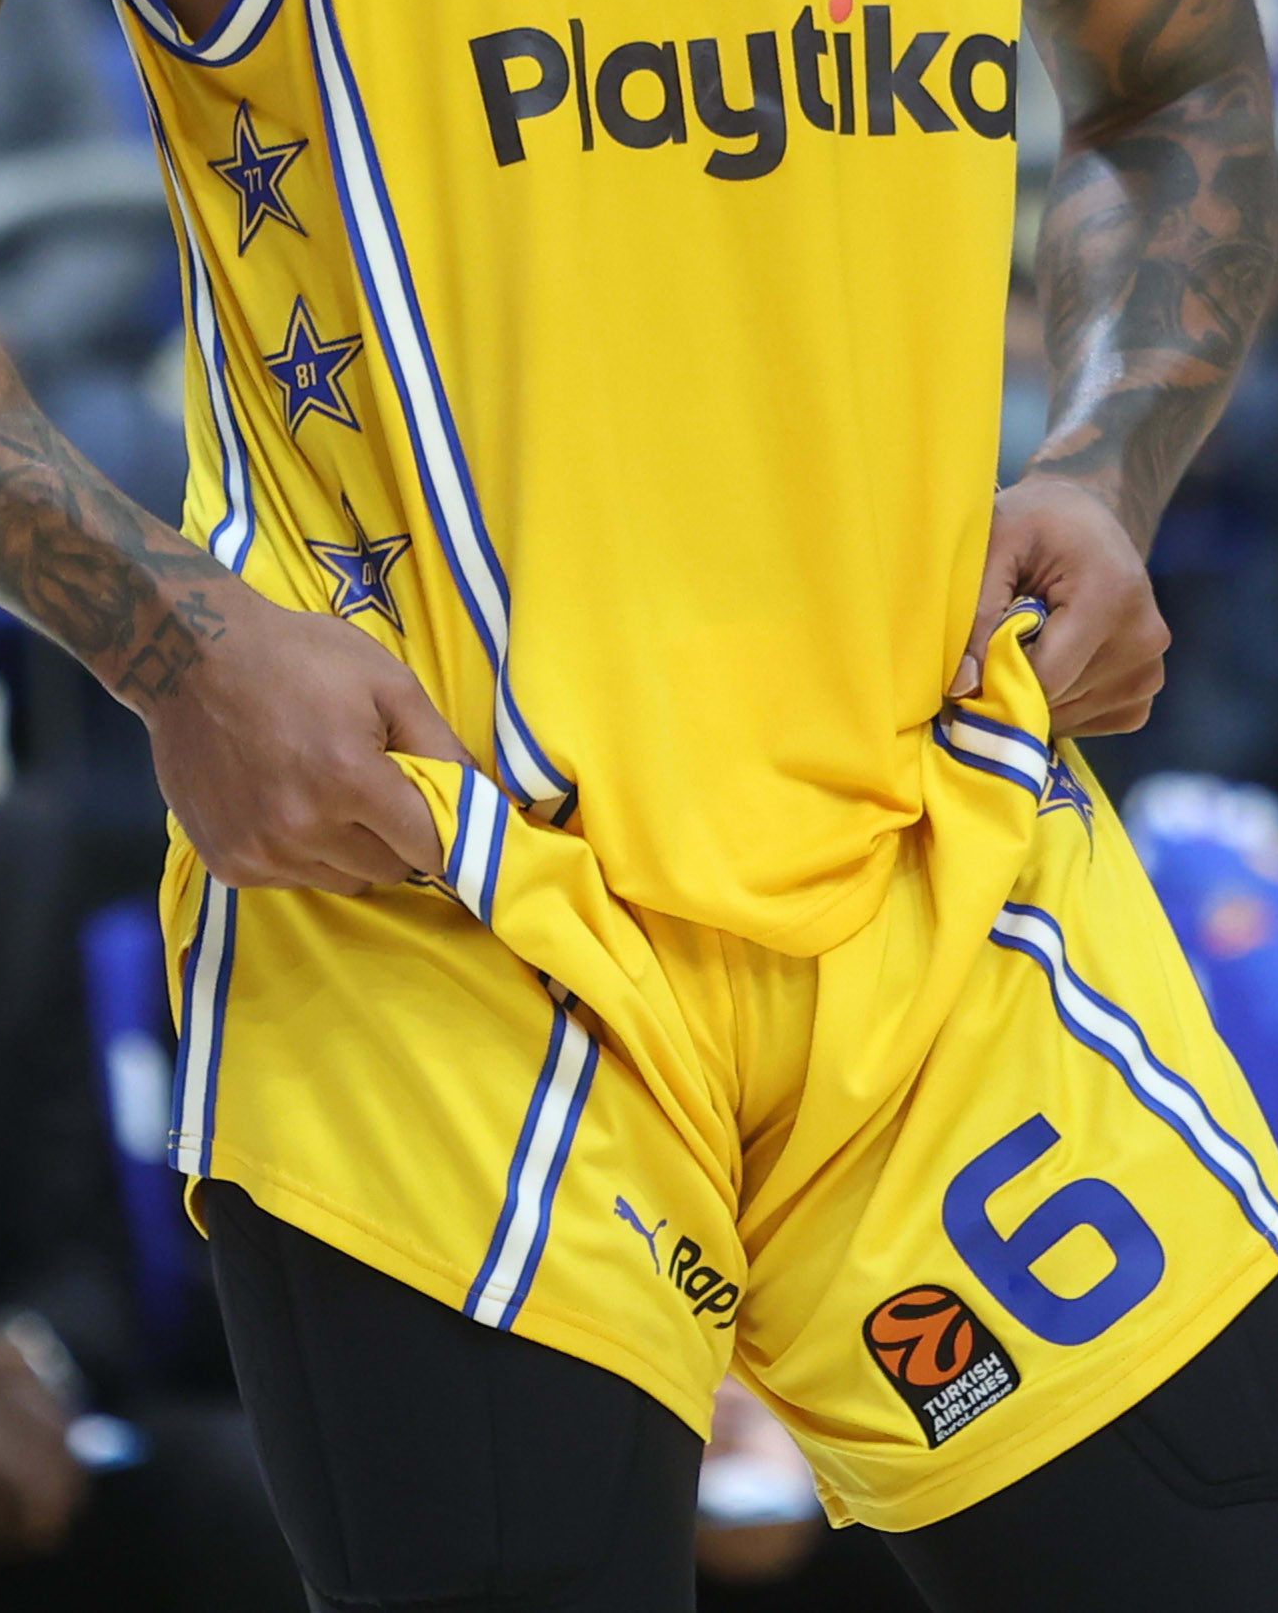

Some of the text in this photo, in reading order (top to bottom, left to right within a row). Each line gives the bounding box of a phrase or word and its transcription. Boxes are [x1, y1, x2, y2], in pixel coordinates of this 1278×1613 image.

[243, 167, 262, 193] 77
[295, 361, 318, 389] 81
[941, 1112, 1165, 1346] 6
[922, 1352, 1001, 1417] TURKISH
[933, 1367, 1010, 1433] AIRLINES
